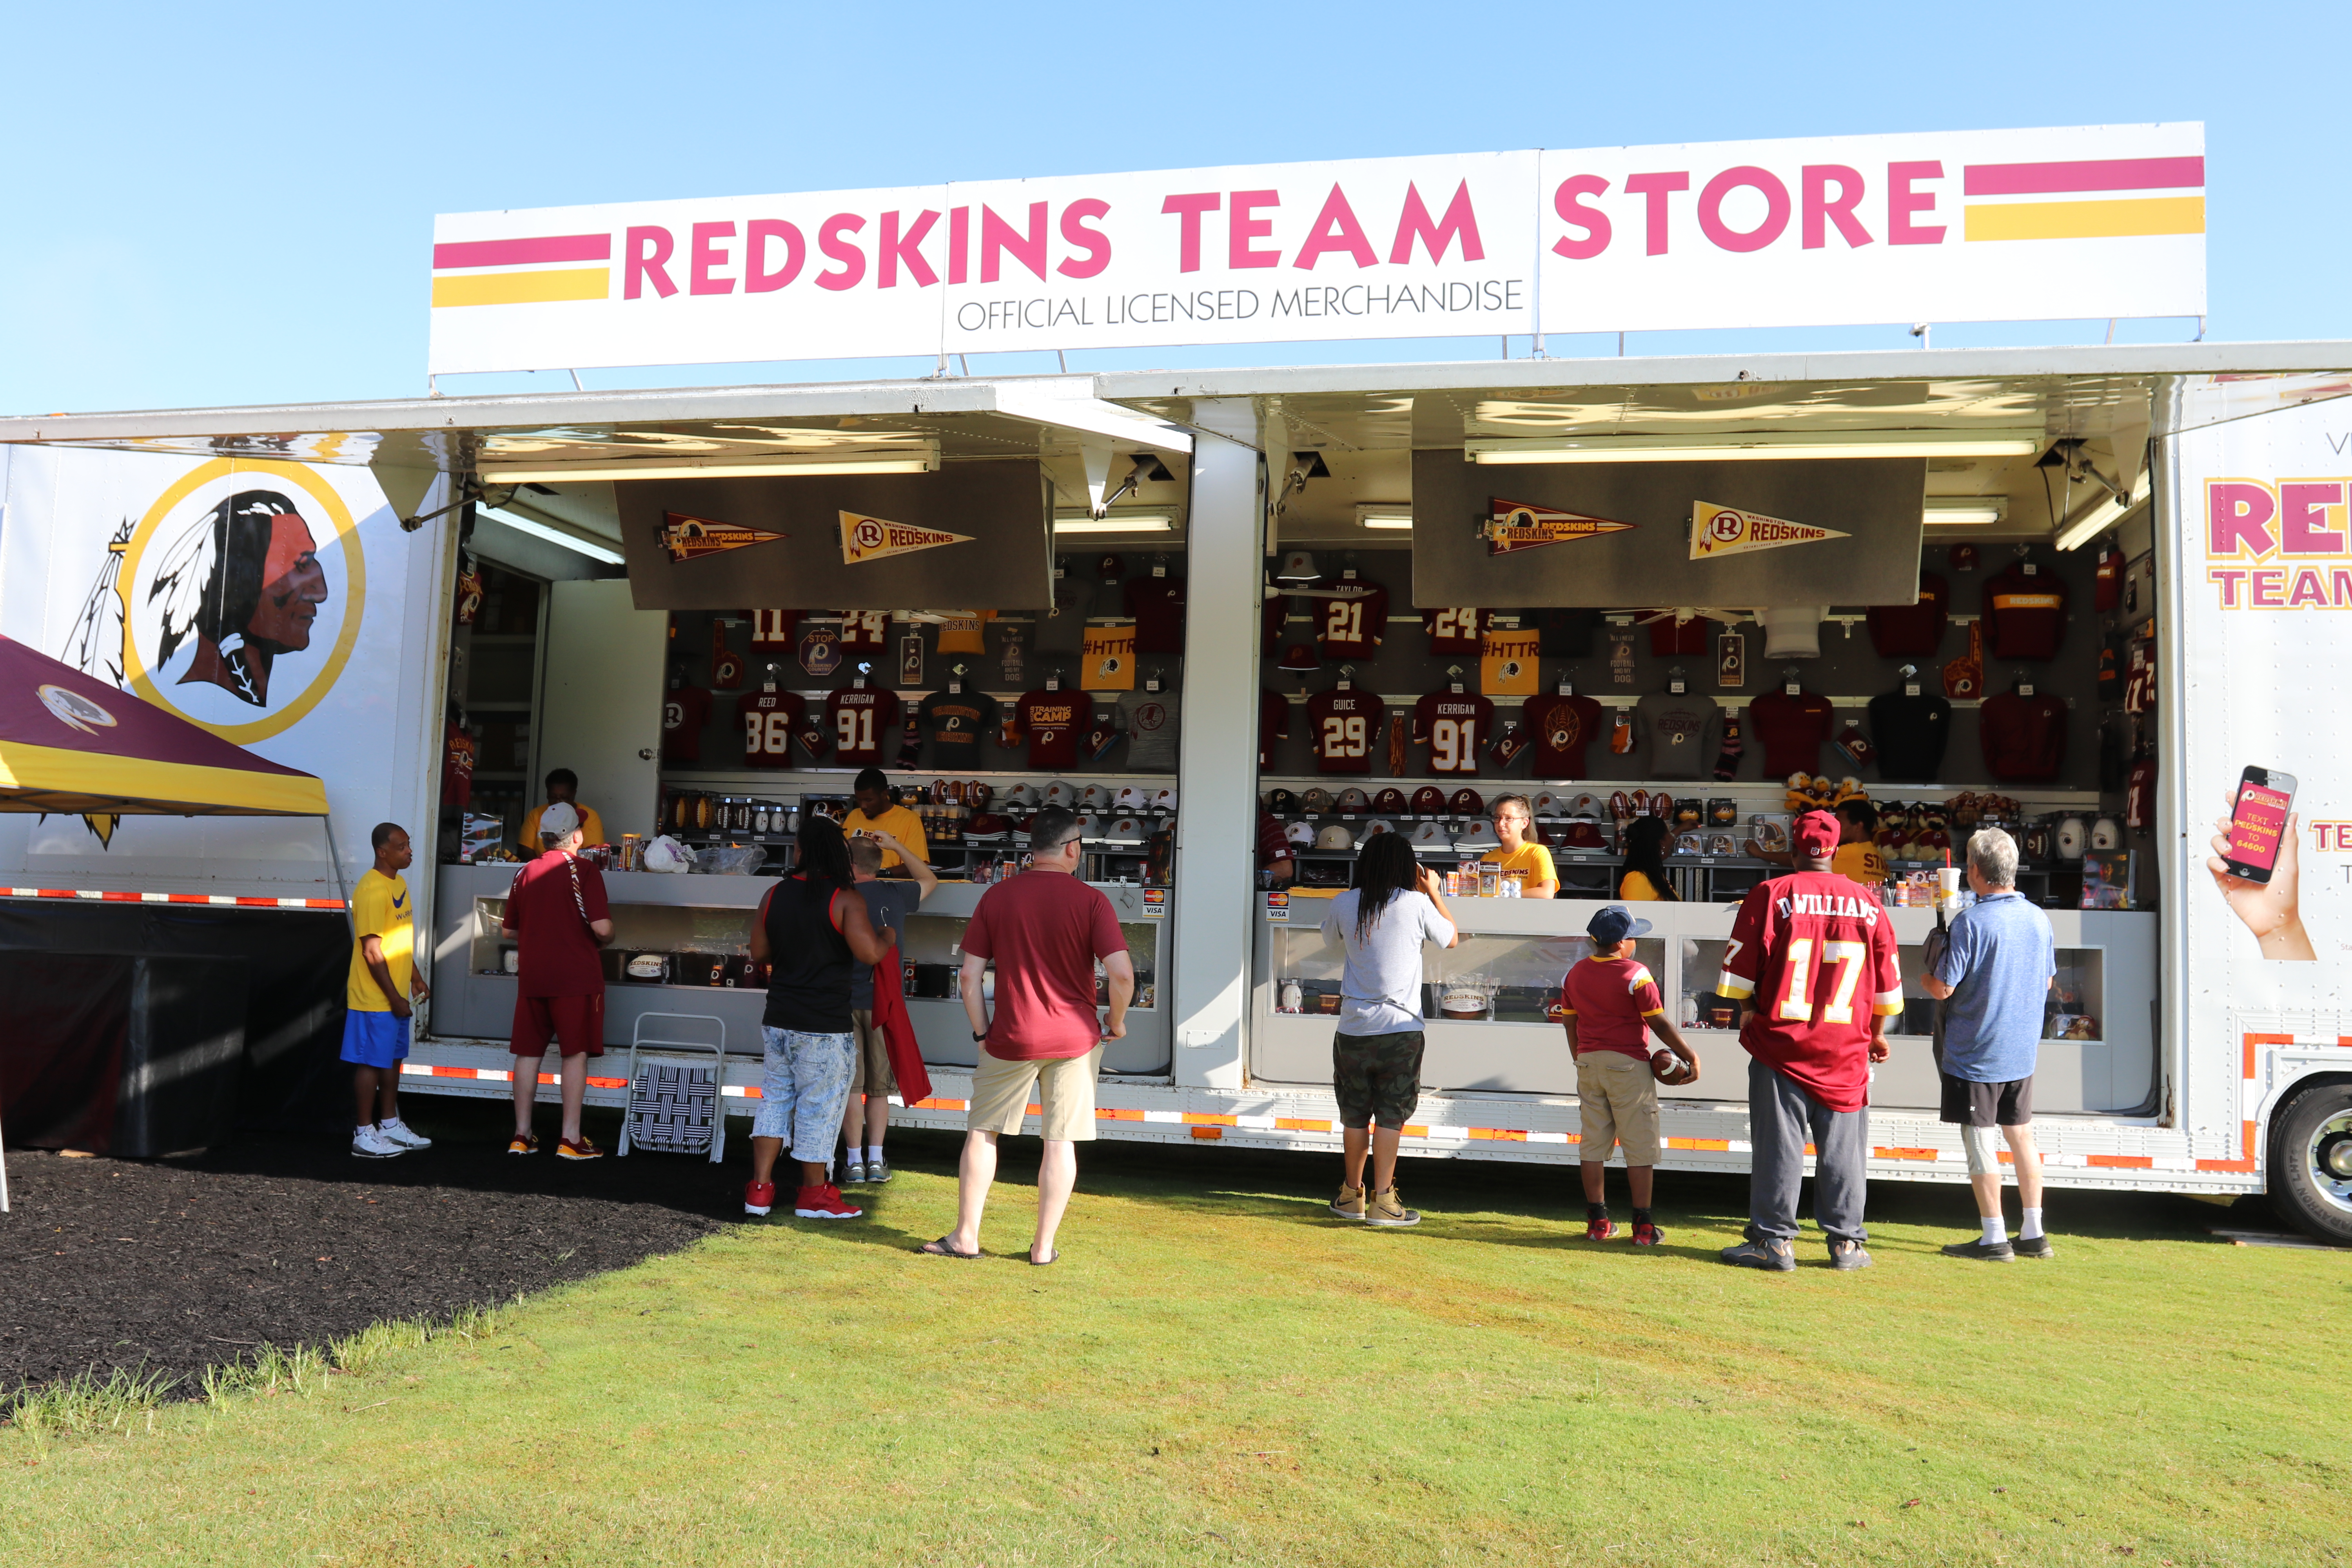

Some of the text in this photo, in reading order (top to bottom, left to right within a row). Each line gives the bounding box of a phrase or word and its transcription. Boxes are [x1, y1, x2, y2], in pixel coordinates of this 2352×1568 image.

[624, 161, 1947, 300] REDSKINS TEAM STORE
[958, 280, 1522, 330] OFFICIAL LICENSED MERCHANDISE
[884, 522, 917, 531] WASHINGTON
[1542, 522, 1596, 531] REDSKINS
[1747, 514, 1785, 526] WASHINGTON
[2204, 477, 2352, 565] RE
[709, 532, 753, 541] REDSKINS
[889, 528, 953, 546] REDSKINS
[1507, 528, 1554, 539] REDSKINS
[1750, 522, 1826, 541] REDSKINS
[682, 537, 720, 547] REDSKINS
[752, 609, 785, 641] 11
[841, 610, 884, 643] 24
[1328, 601, 1363, 642] 21
[1436, 608, 1477, 640] 24
[808, 634, 834, 643] STOP
[1083, 638, 1135, 655] #HTTR
[1483, 641, 1539, 658] #HTTR
[758, 697, 776, 707] REED
[840, 694, 875, 704] KERRIGAN
[1334, 699, 1356, 710] GUICE
[931, 705, 981, 722] WASHINGTON
[1033, 712, 1071, 722] CAMP
[1437, 704, 1475, 715] KERRIGAN
[745, 712, 789, 754] 86
[837, 709, 875, 751] 91
[1658, 719, 1701, 732] REDSKINS
[935, 731, 974, 743] REDSKINS
[1324, 717, 1366, 757] 29
[1432, 719, 1476, 771] 91
[2255, 793, 2288, 807] REDSKINS
[2247, 812, 2269, 824] TEXT
[2234, 819, 2278, 837] REDSKINS
[2248, 832, 2260, 842] TO
[2236, 839, 2266, 853] 64600
[1776, 893, 1879, 926] D.WILLIAMS
[1891, 953, 1902, 981] 1
[1779, 938, 1866, 1024] 17
[2298, 1187, 2352, 1232] ARATHON
